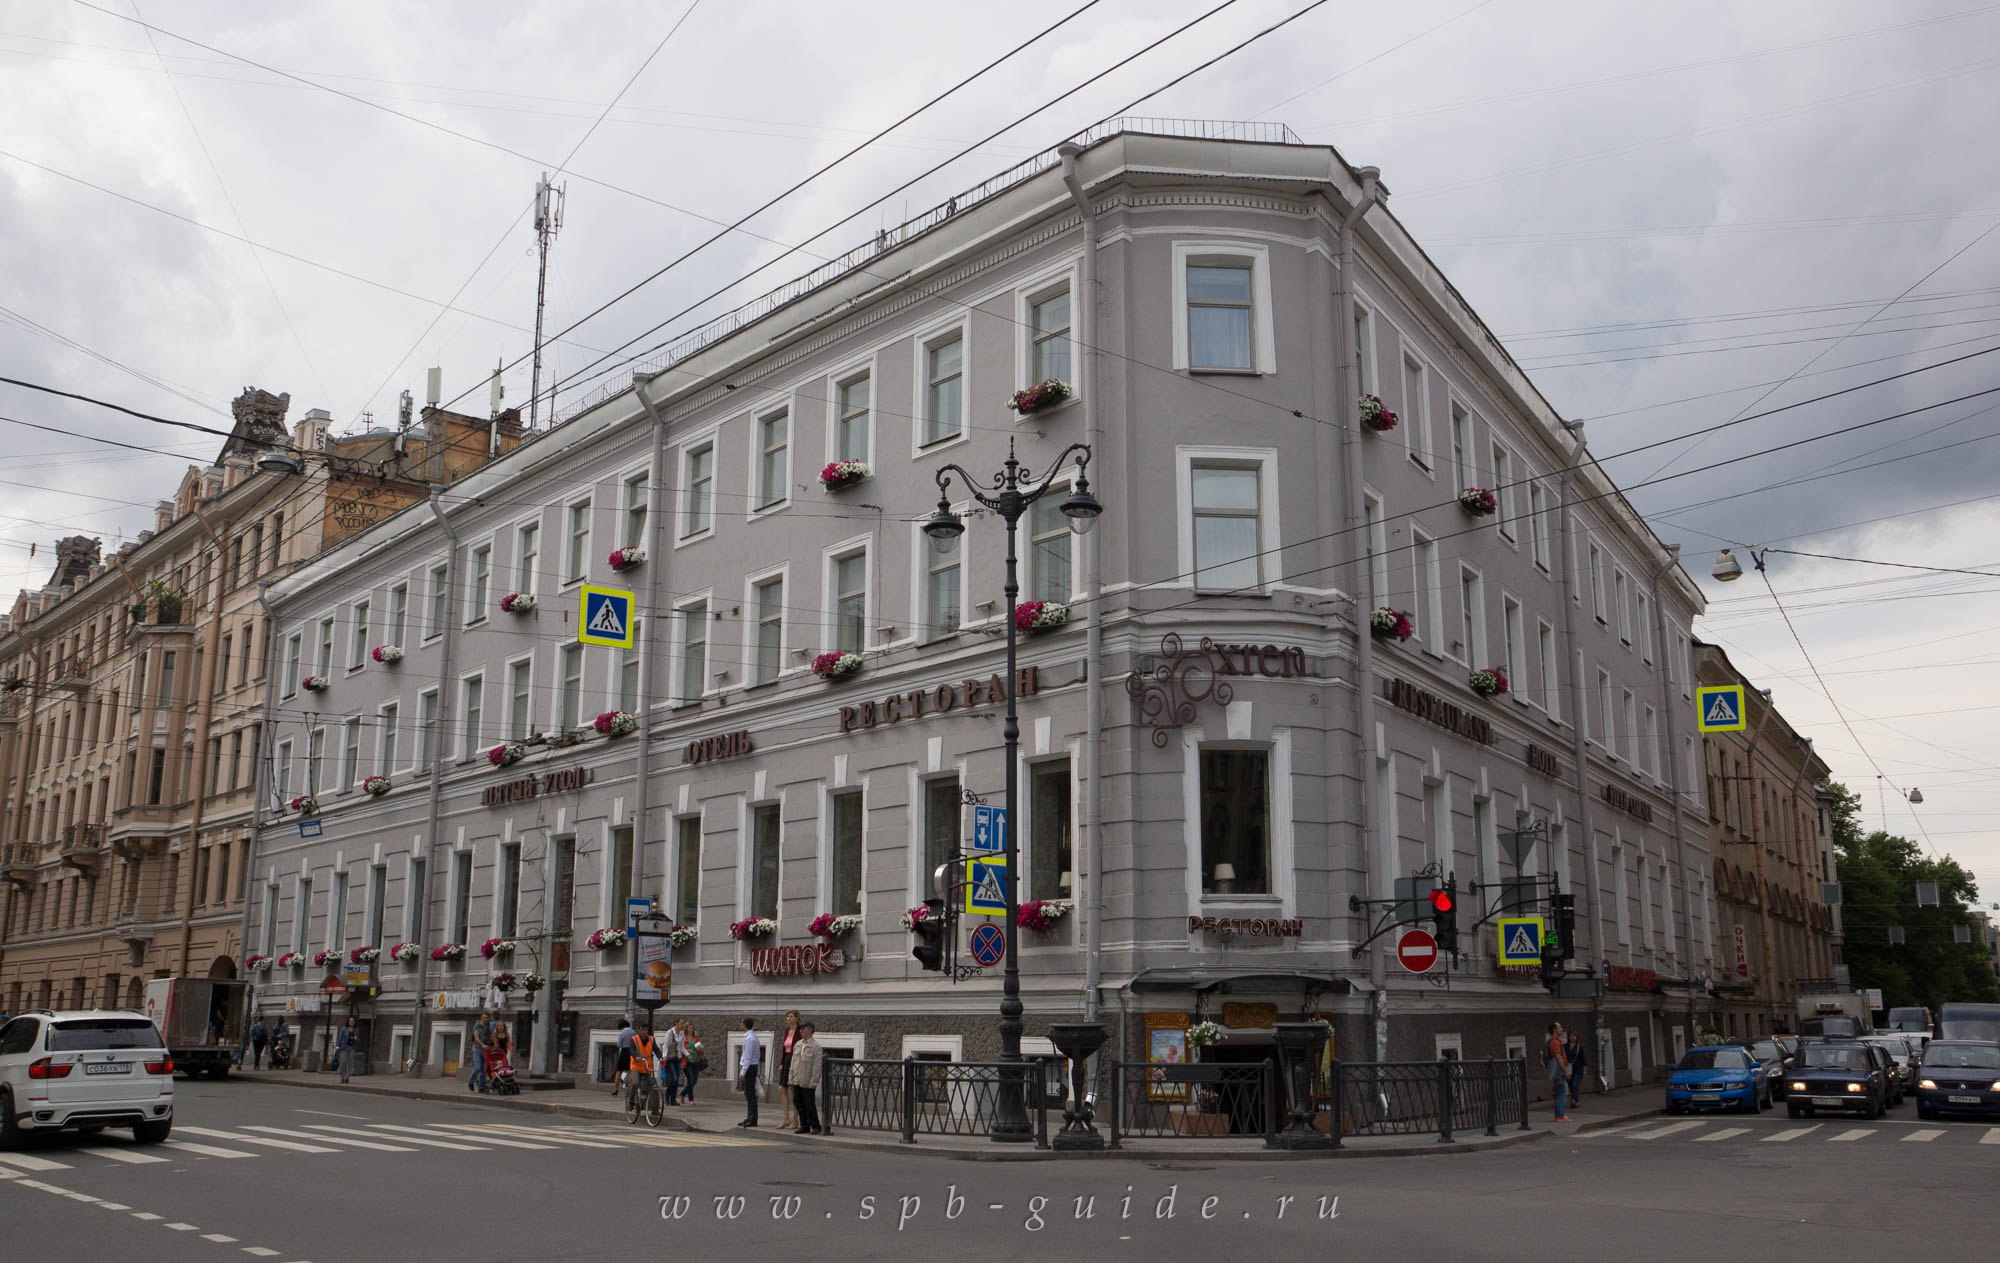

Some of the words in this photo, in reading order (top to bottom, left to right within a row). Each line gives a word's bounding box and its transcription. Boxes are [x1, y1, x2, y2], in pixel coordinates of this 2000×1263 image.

[839, 666, 1038, 732] РЕСТОРАН
[686, 730, 753, 764] ОТЕЛЬ
[485, 773, 536, 806] ПЯТЫЙ
[543, 767, 584, 794] УГОЛ
[1188, 915, 1303, 937] РЕСТОРАН
[751, 943, 837, 976] ШИНОК
[1735, 927, 1745, 962] ОЧКИ
